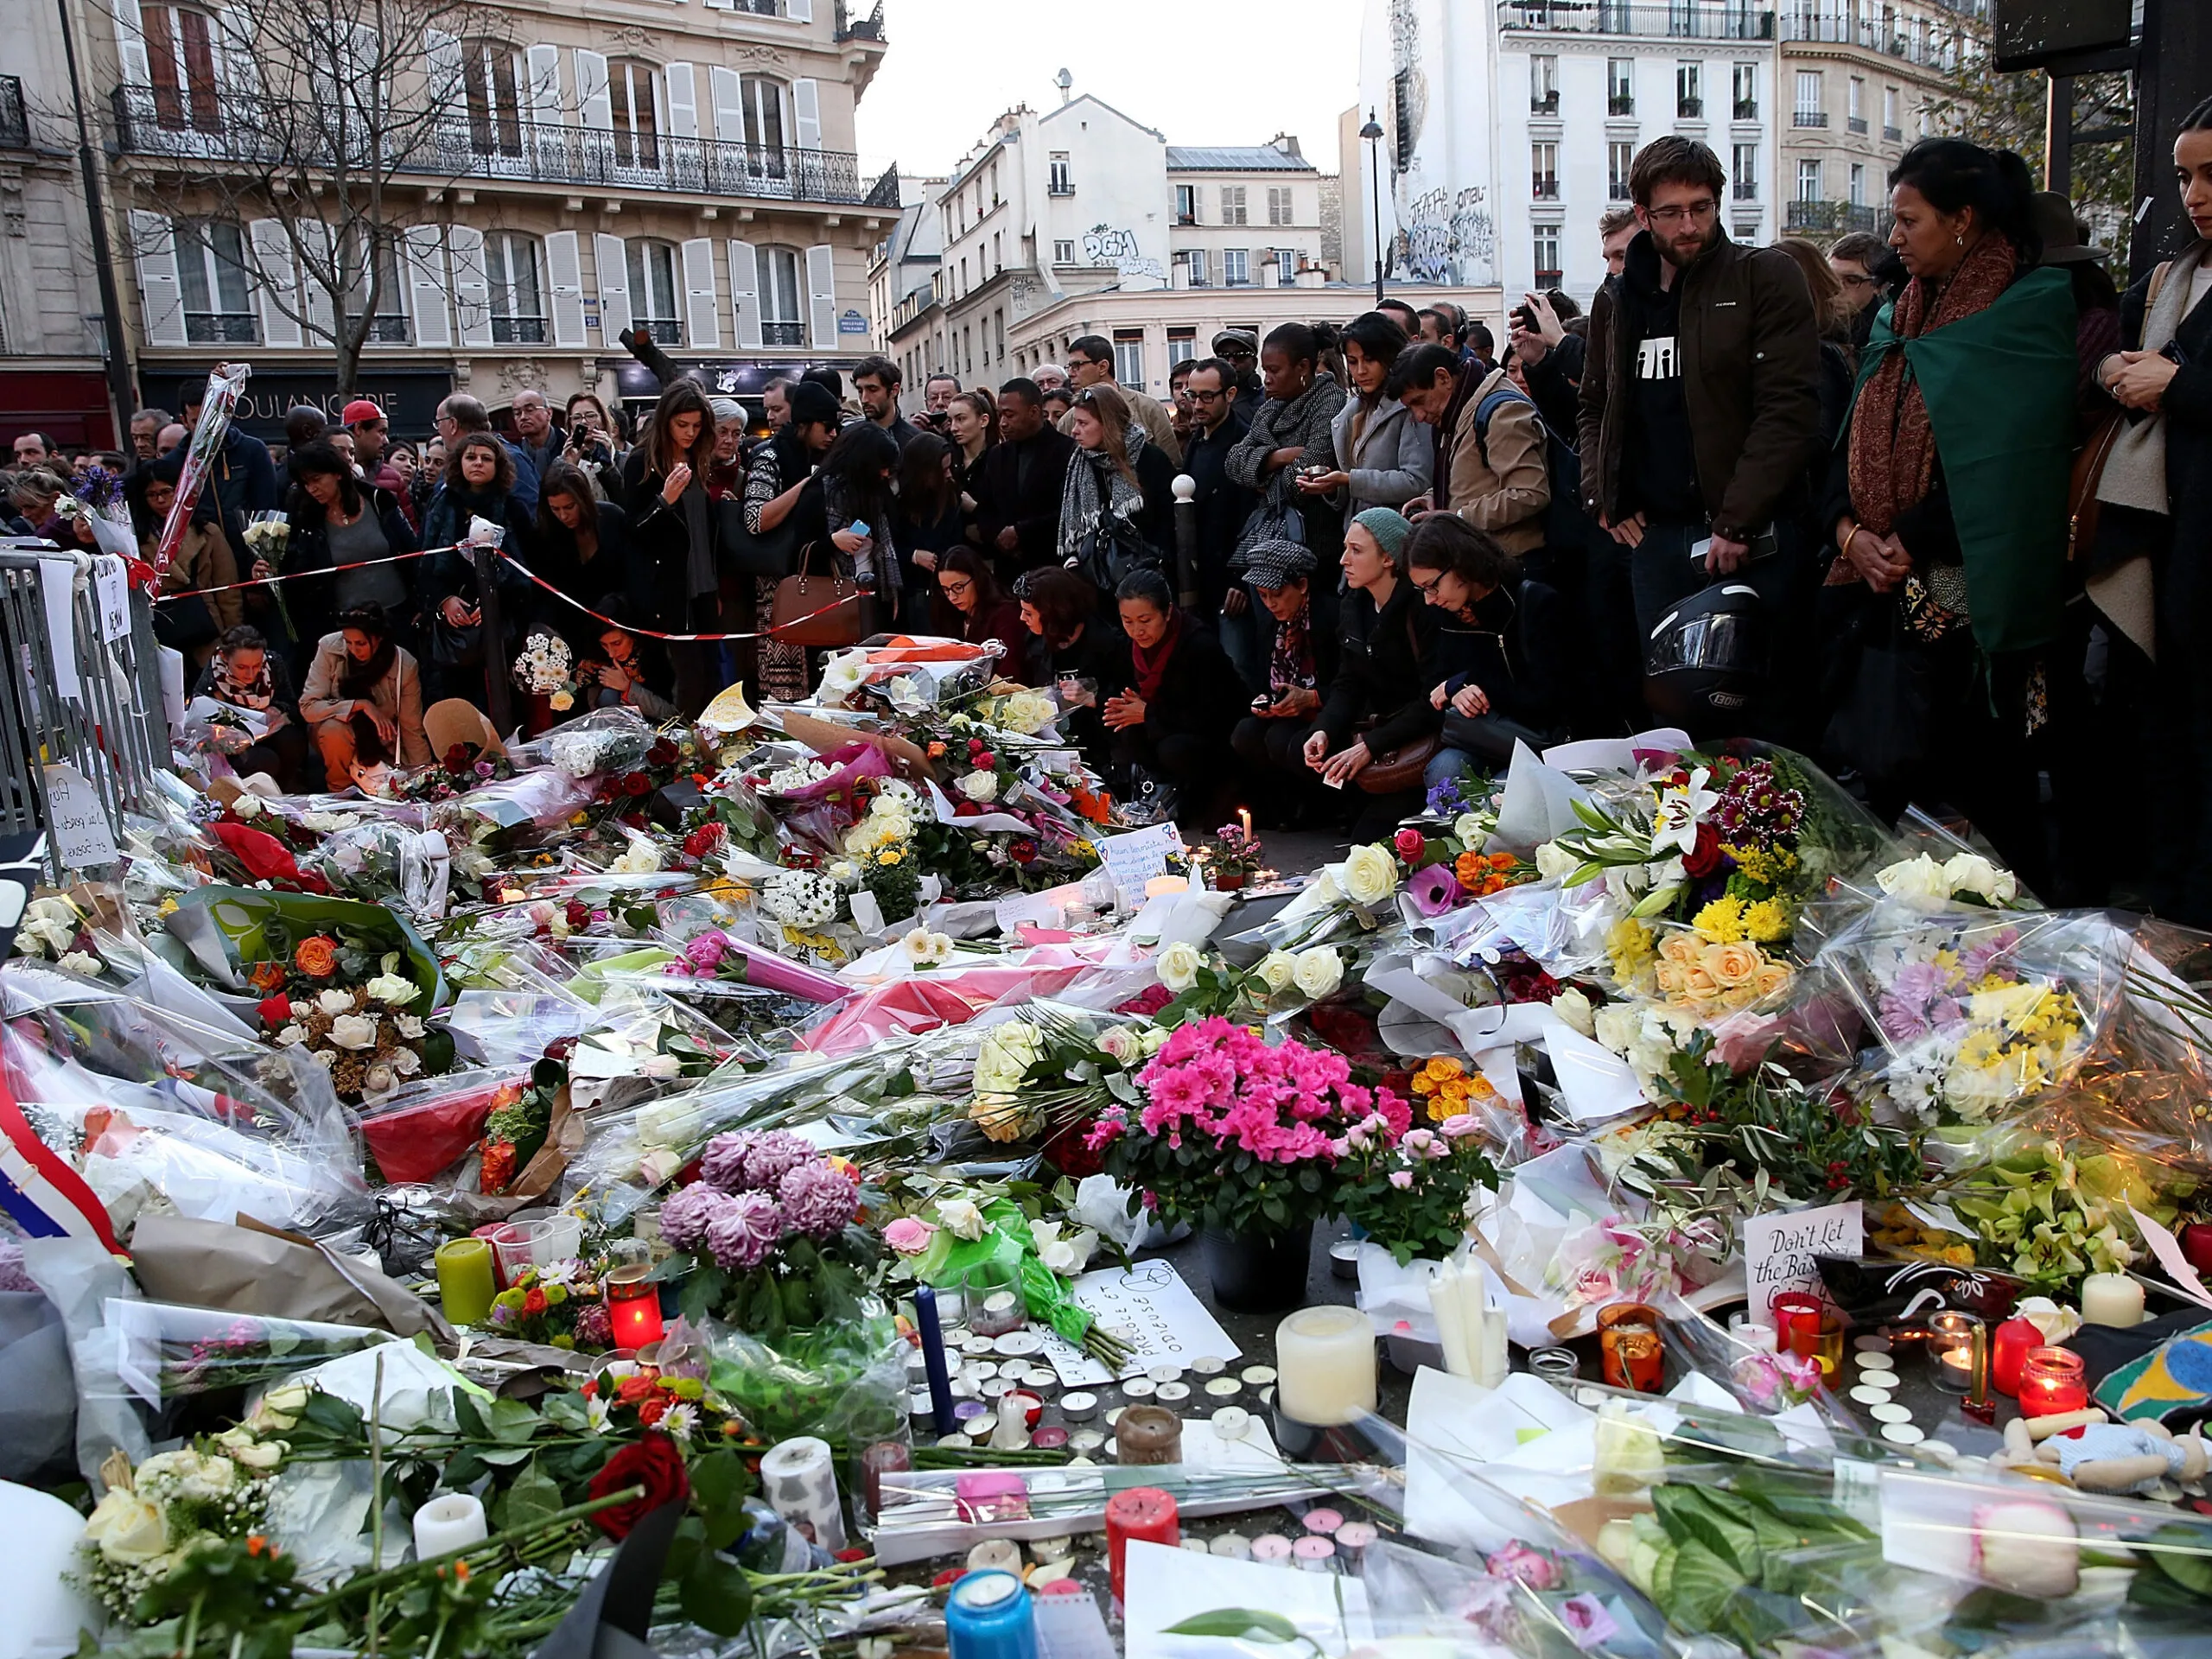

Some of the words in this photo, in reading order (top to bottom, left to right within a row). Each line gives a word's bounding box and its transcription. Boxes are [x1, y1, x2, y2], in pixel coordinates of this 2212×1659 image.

[1083, 229, 1139, 260] DGM
[587, 317, 598, 327] 28
[1713, 694, 1745, 707] SHOEI
[1769, 1224, 1816, 1254] Don't
[1818, 1218, 1845, 1252] Let
[1753, 1255, 1782, 1283] the
[1099, 1286, 1120, 1300] ET
